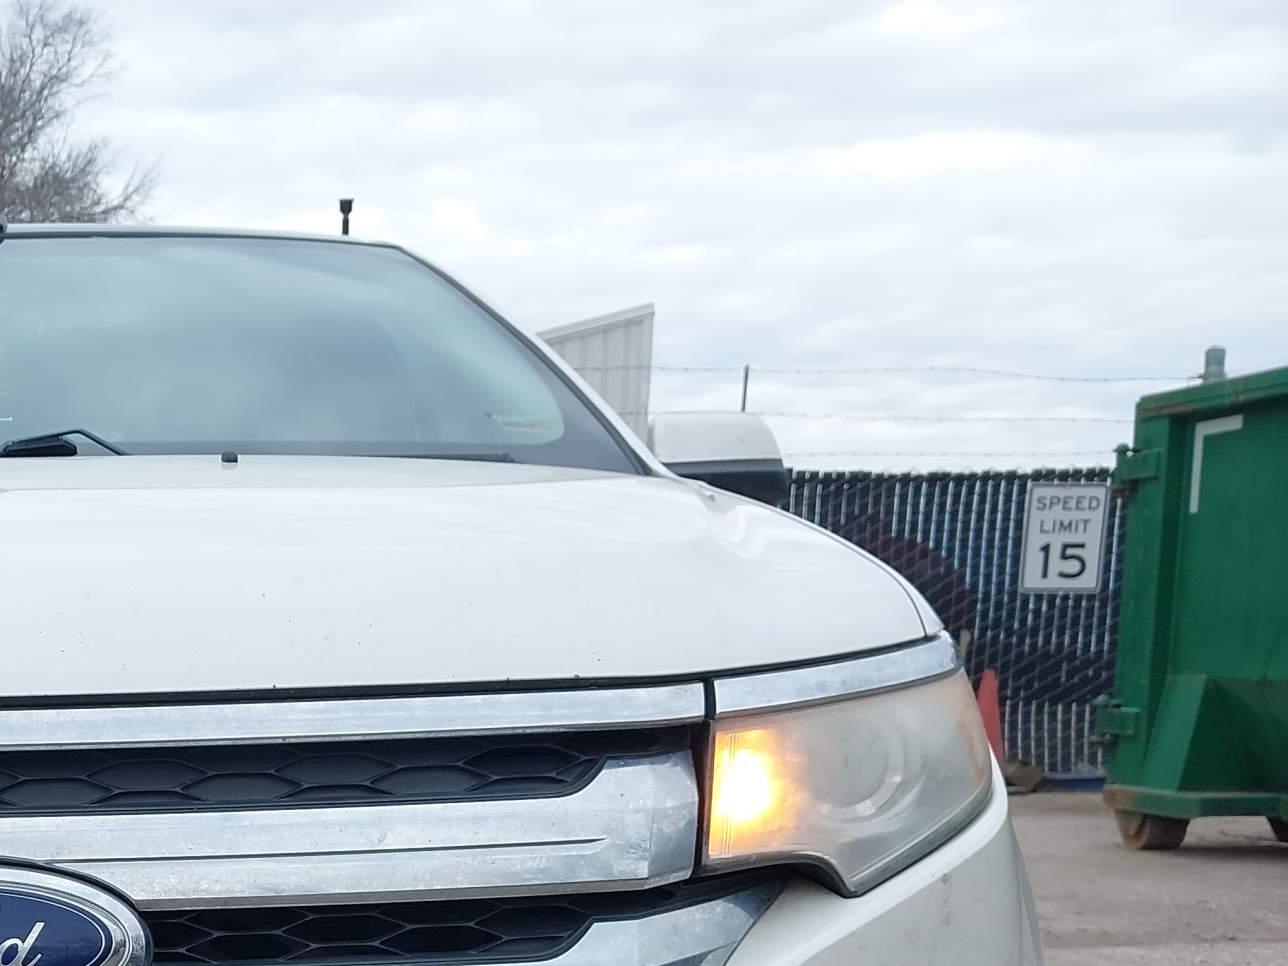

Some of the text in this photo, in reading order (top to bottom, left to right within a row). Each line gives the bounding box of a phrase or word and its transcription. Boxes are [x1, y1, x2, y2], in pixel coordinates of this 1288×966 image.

[1035, 495, 1101, 511] SPEED
[1039, 518, 1092, 534] LIMIT
[1039, 542, 1087, 579] 15
